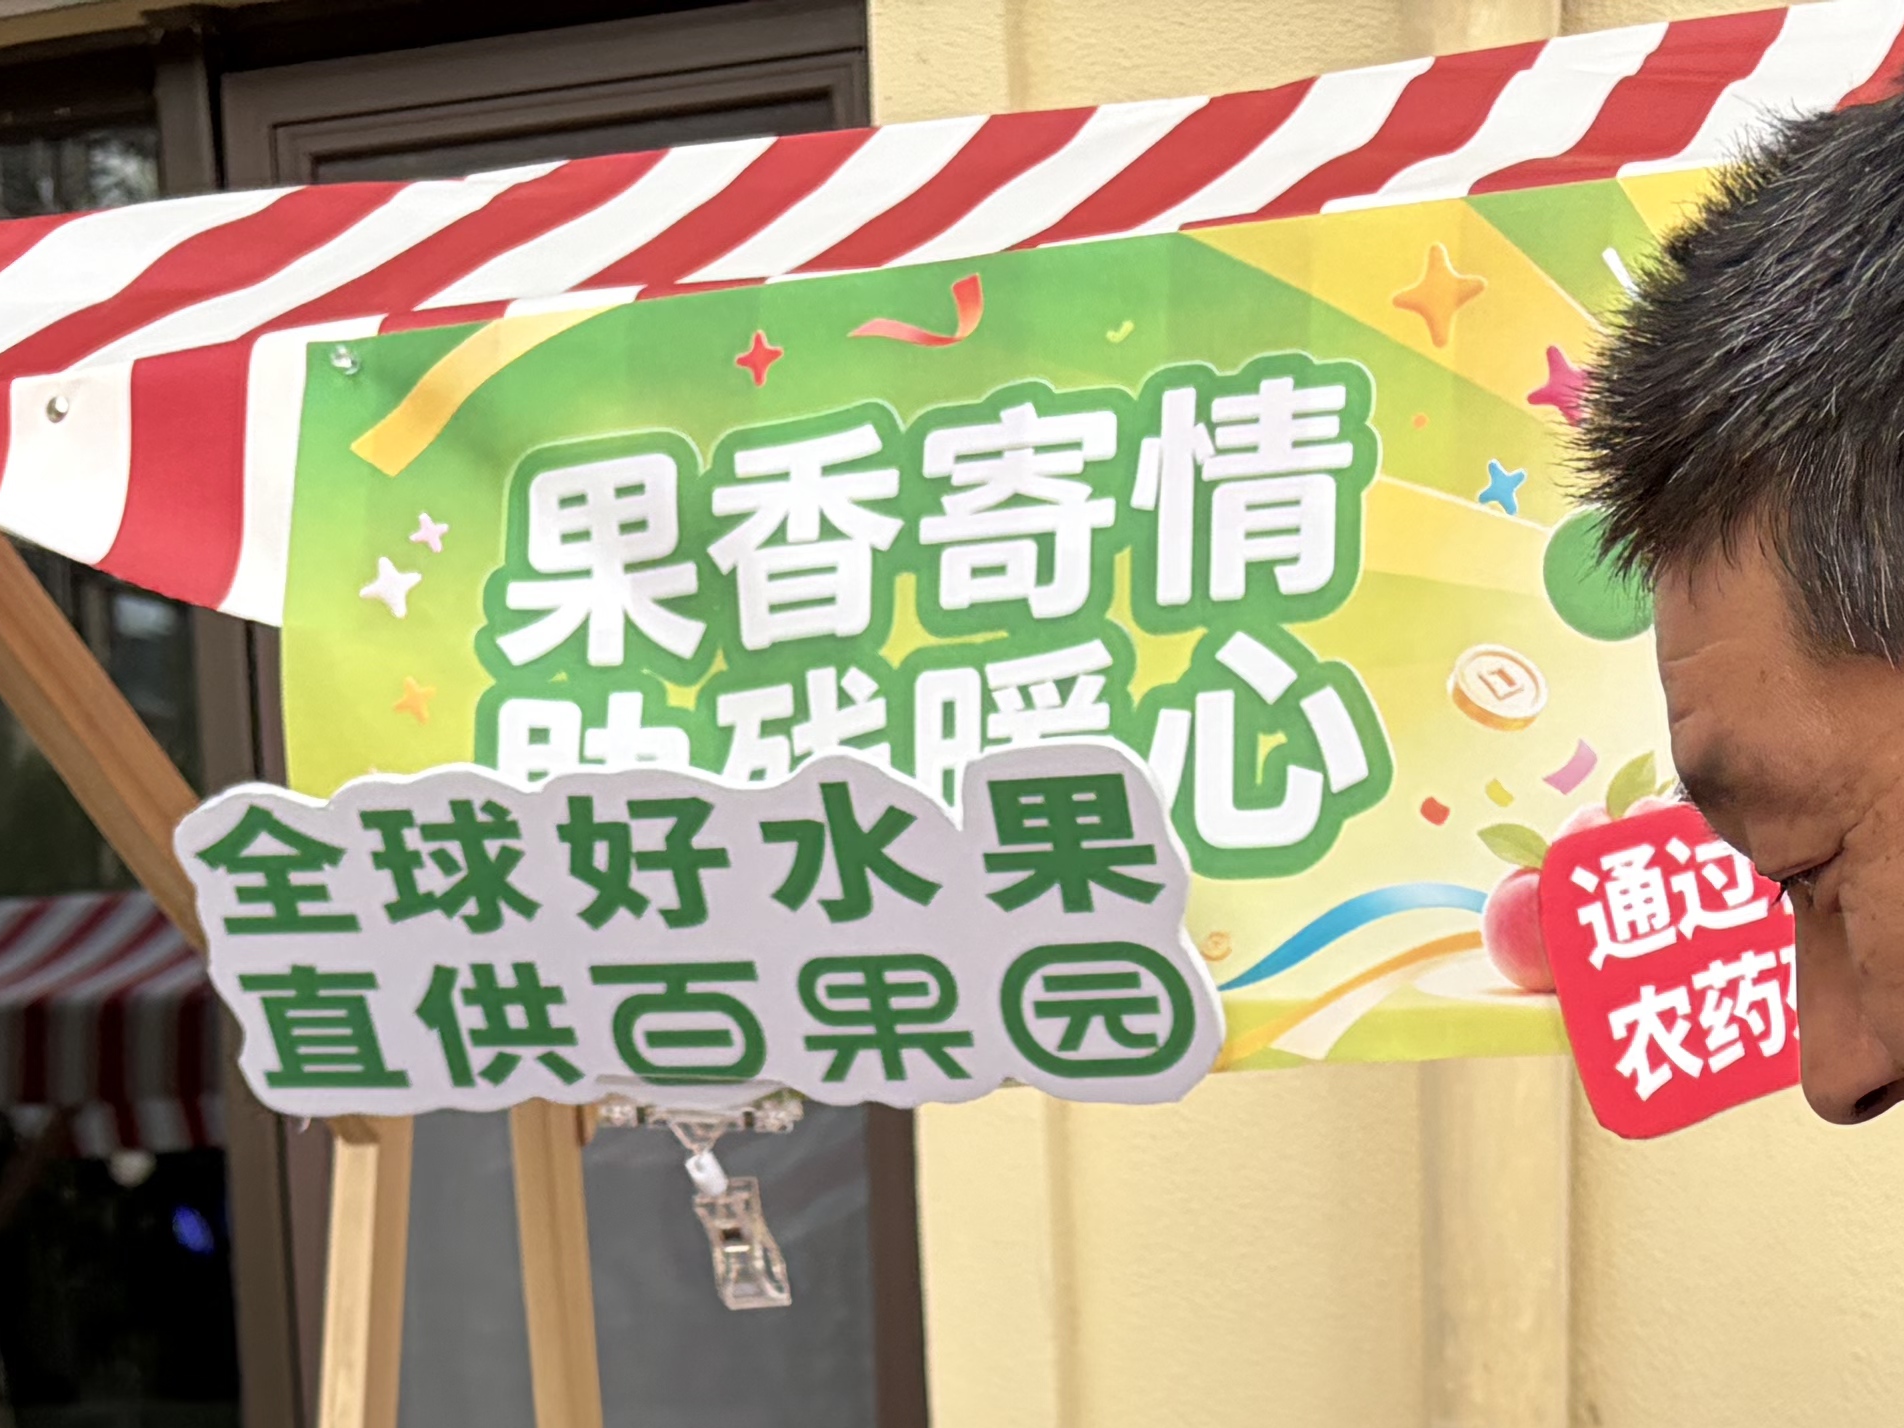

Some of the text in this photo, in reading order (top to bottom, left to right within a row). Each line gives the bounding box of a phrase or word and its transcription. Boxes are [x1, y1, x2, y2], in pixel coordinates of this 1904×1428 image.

[496, 376, 1354, 667] 果香寄情
[197, 772, 1166, 935] 全球好水果
[1569, 837, 1794, 970] 通过
[238, 941, 1196, 1089] 直供百果园
[1607, 944, 1800, 1101] 农药
